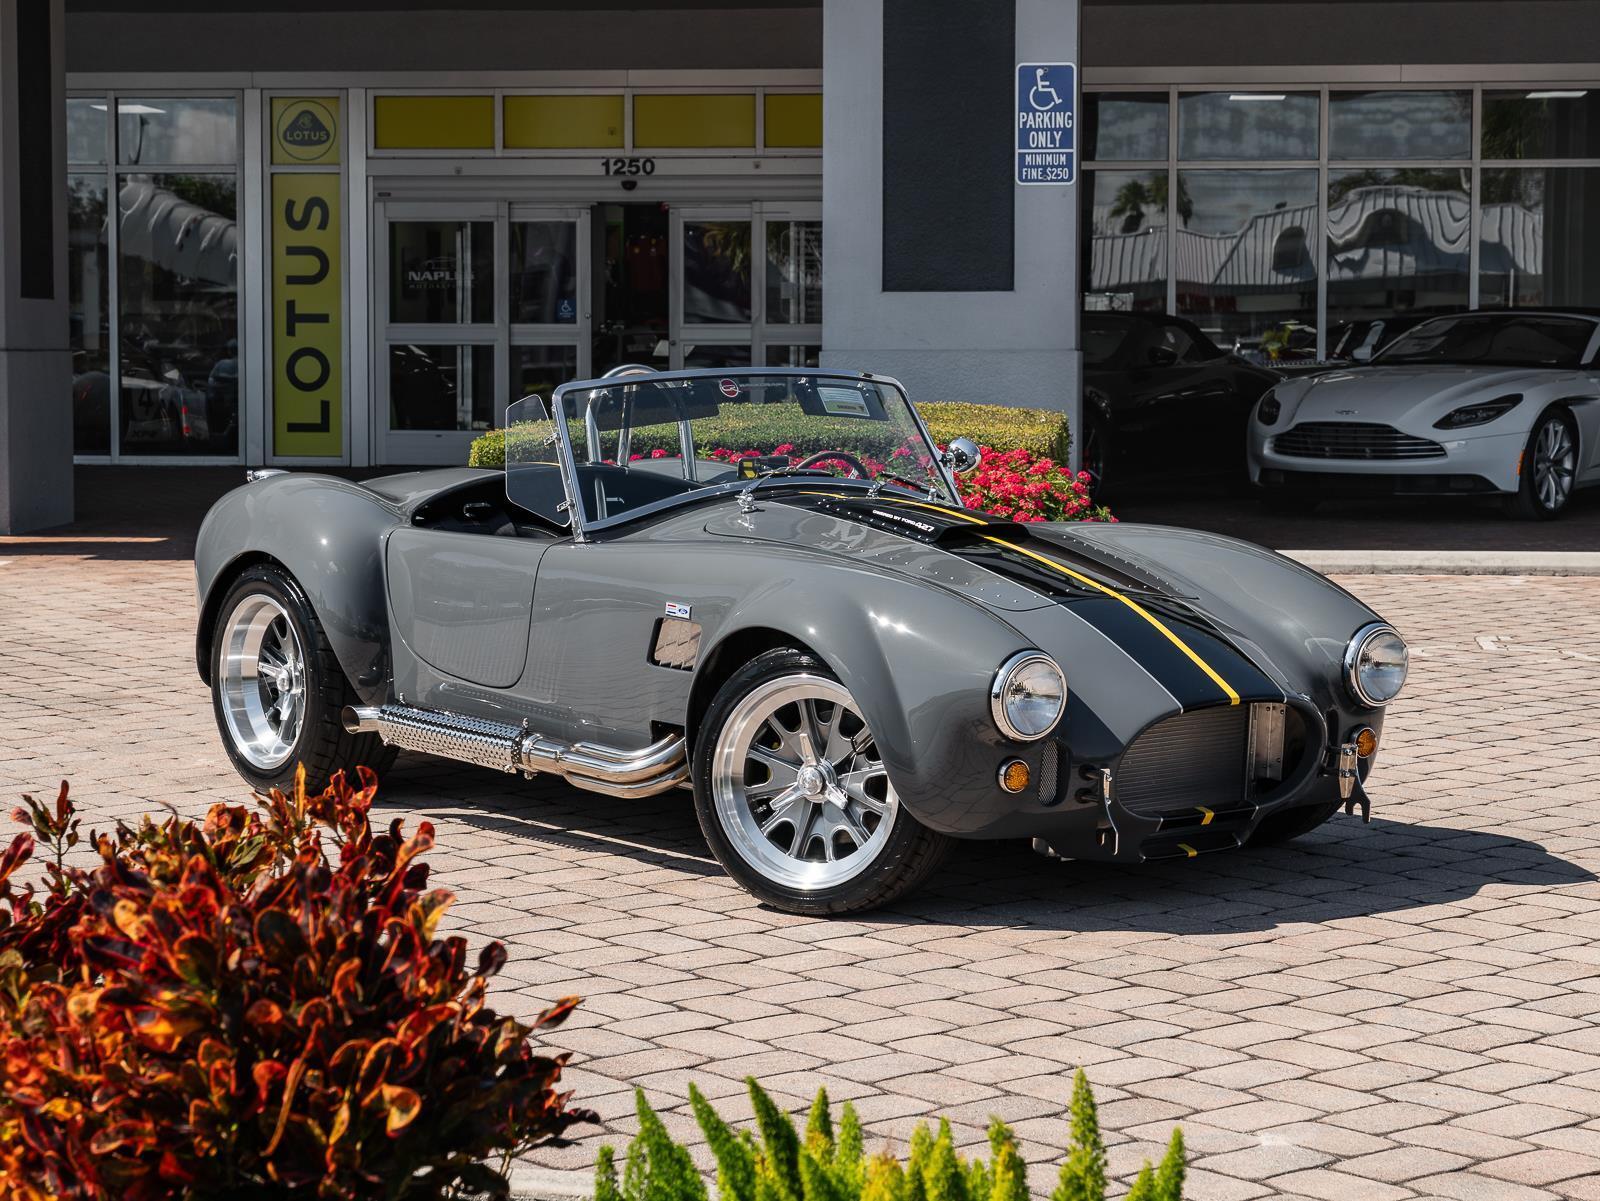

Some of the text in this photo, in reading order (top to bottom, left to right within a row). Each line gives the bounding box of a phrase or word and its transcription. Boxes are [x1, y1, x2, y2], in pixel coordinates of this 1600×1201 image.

[1019, 112, 1072, 128] PARKING
[286, 131, 328, 141] LOTUS
[1029, 131, 1062, 148] ONLY
[1025, 154, 1066, 166] MINIMUM
[601, 159, 655, 176] 1250
[1022, 168, 1069, 181] FINE $250
[286, 196, 330, 433] LOTUS
[916, 521, 935, 533] 427
